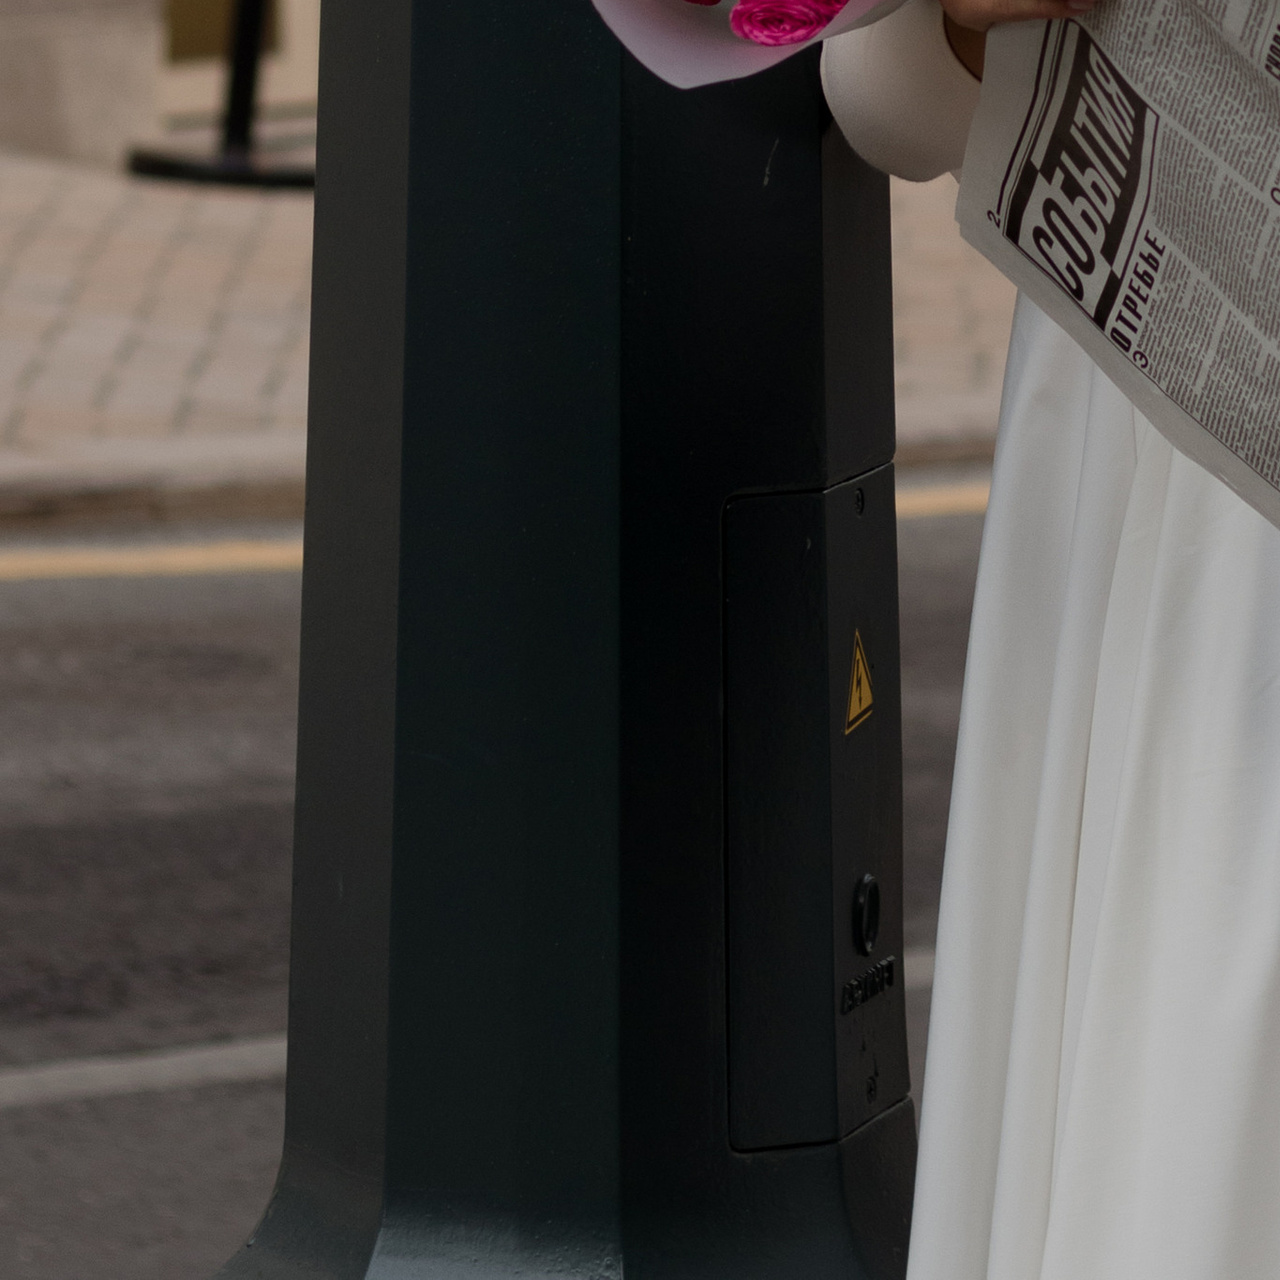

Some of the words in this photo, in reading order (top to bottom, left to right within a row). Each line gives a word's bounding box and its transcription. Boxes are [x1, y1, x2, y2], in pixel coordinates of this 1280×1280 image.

[987, 209, 1001, 228] 2
[1032, 42, 1136, 302] СОБЫТИЯ
[1109, 229, 1166, 353] ОТРЕБЬЕ
